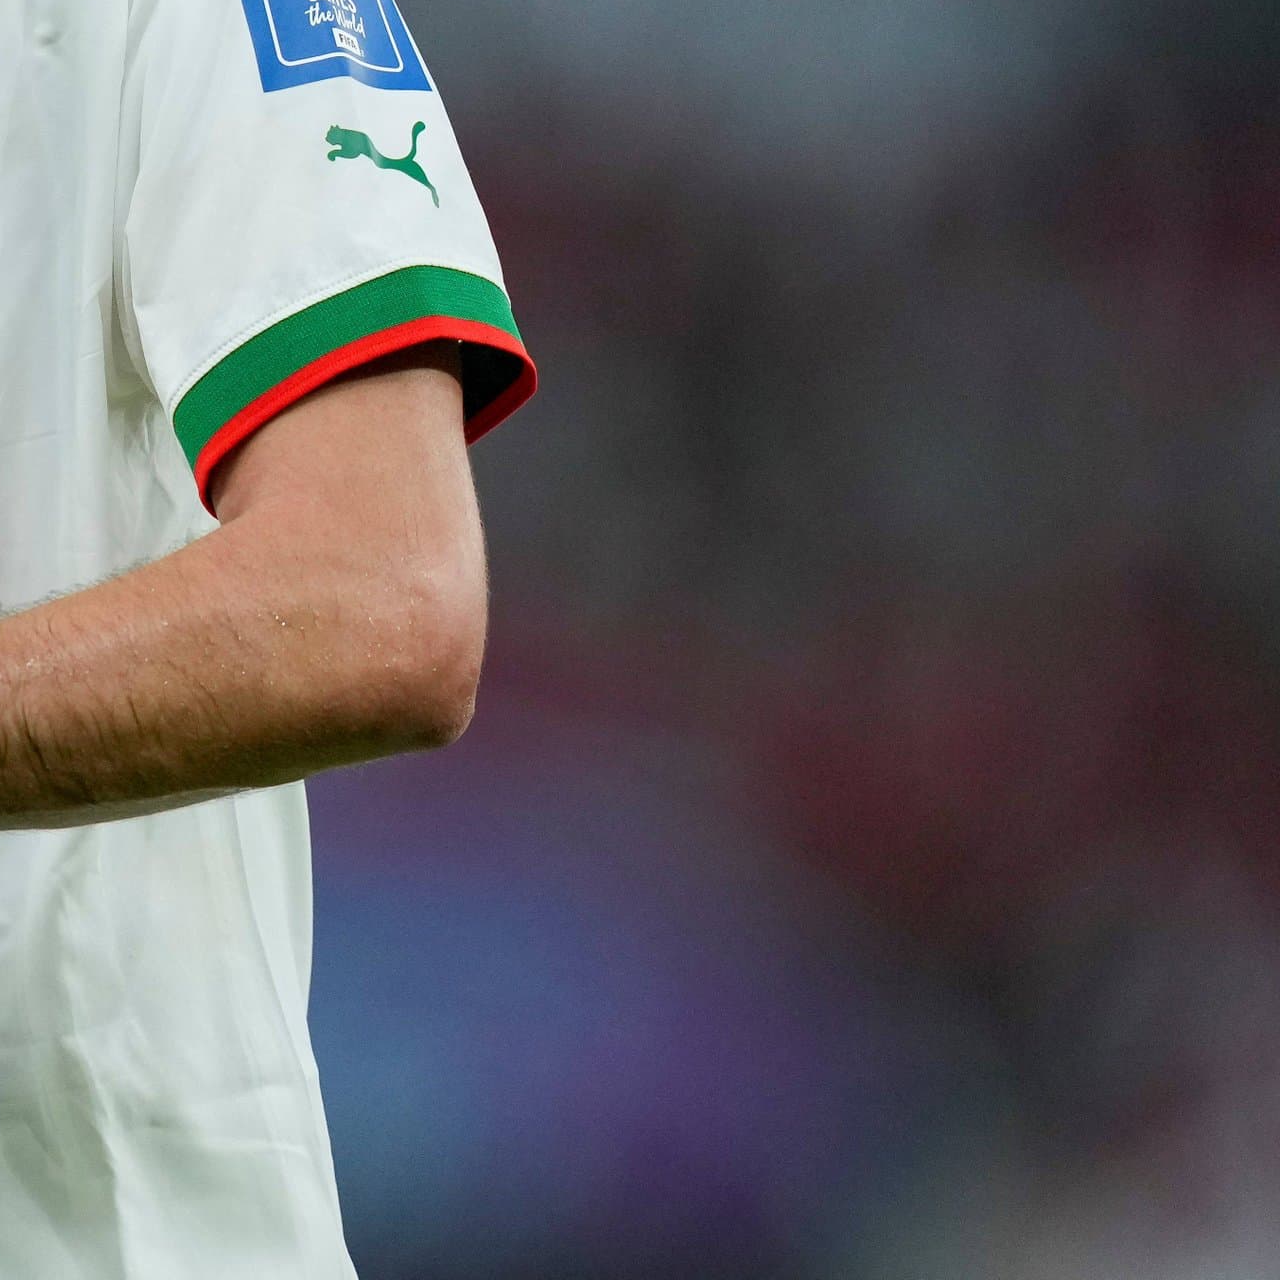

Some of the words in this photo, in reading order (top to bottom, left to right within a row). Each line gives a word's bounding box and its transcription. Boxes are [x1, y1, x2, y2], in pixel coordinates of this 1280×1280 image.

[304, 2, 334, 26] the
[333, 5, 366, 39] World
[338, 32, 358, 51] FIFA
